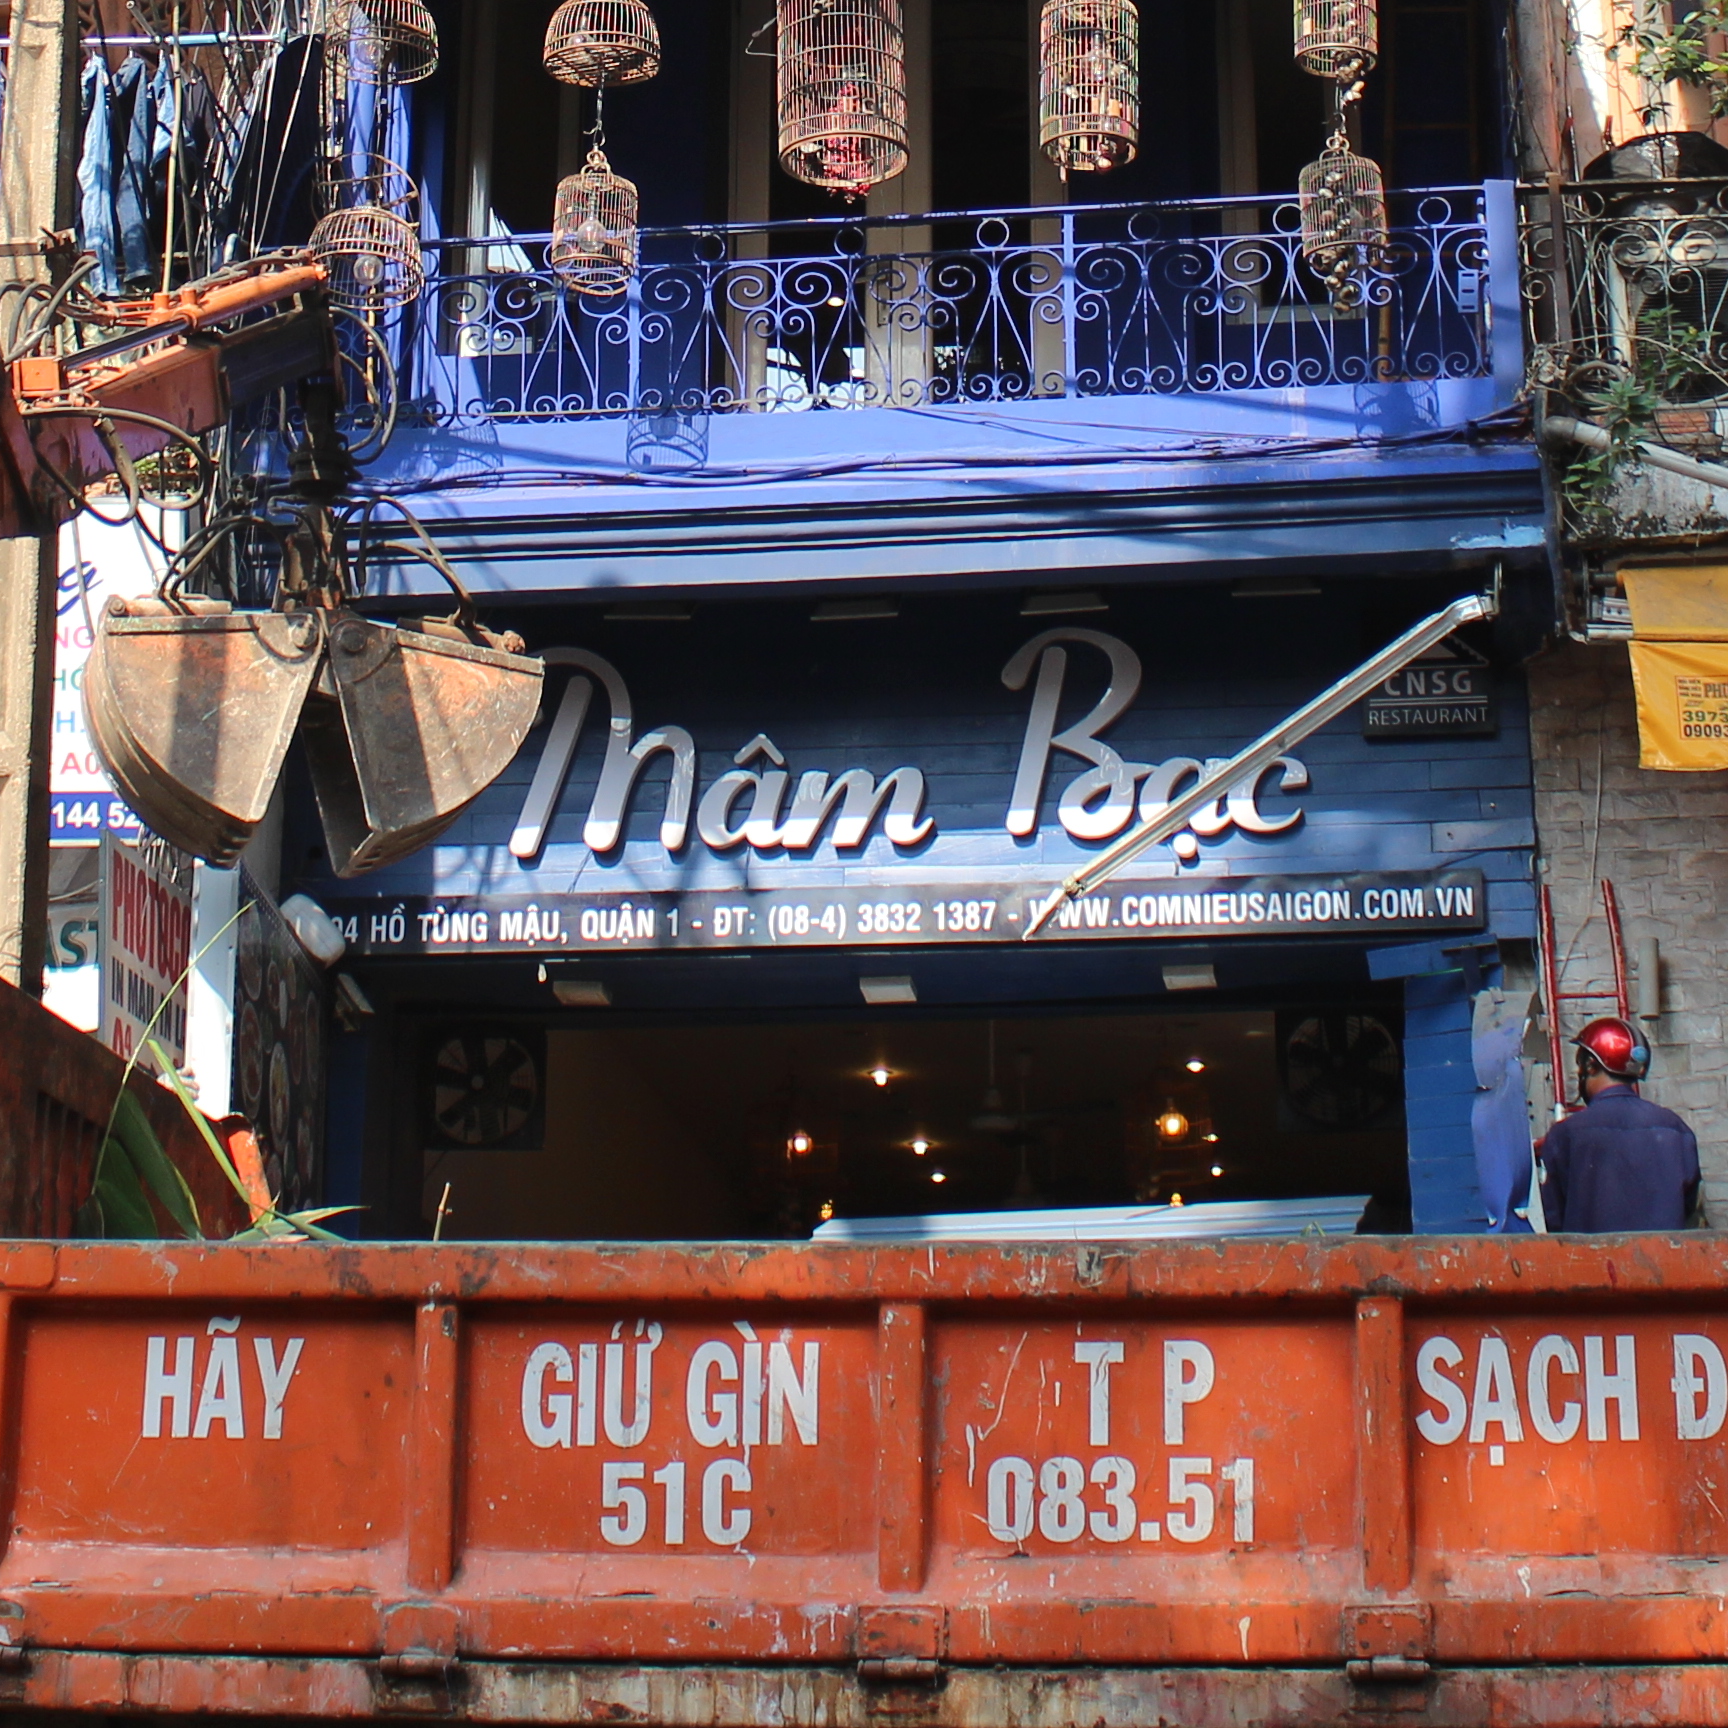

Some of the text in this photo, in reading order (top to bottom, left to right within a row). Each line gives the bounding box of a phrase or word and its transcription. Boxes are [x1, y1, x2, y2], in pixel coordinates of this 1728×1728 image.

[1384, 670, 1472, 696] CNSG
[1369, 707, 1488, 725] RESTAURANT
[1001, 627, 1308, 863] Bạc
[371, 903, 406, 943] HỒ
[417, 906, 488, 943] TÙNG
[499, 902, 569, 946] MẬU,
[581, 901, 655, 946] QUẬN
[667, 908, 679, 937] 1
[713, 906, 756, 936] ĐT:
[767, 904, 847, 943] (08-4)
[857, 904, 921, 933] 3832
[932, 901, 996, 932] 1387
[111, 956, 123, 1008] IN
[142, 1317, 305, 1440] HÃY
[522, 1317, 661, 1450] GIỮ
[686, 1320, 820, 1448] GÌN
[1415, 1334, 1639, 1467] SẠCH
[601, 1456, 1256, 1547] 51C 083.51
